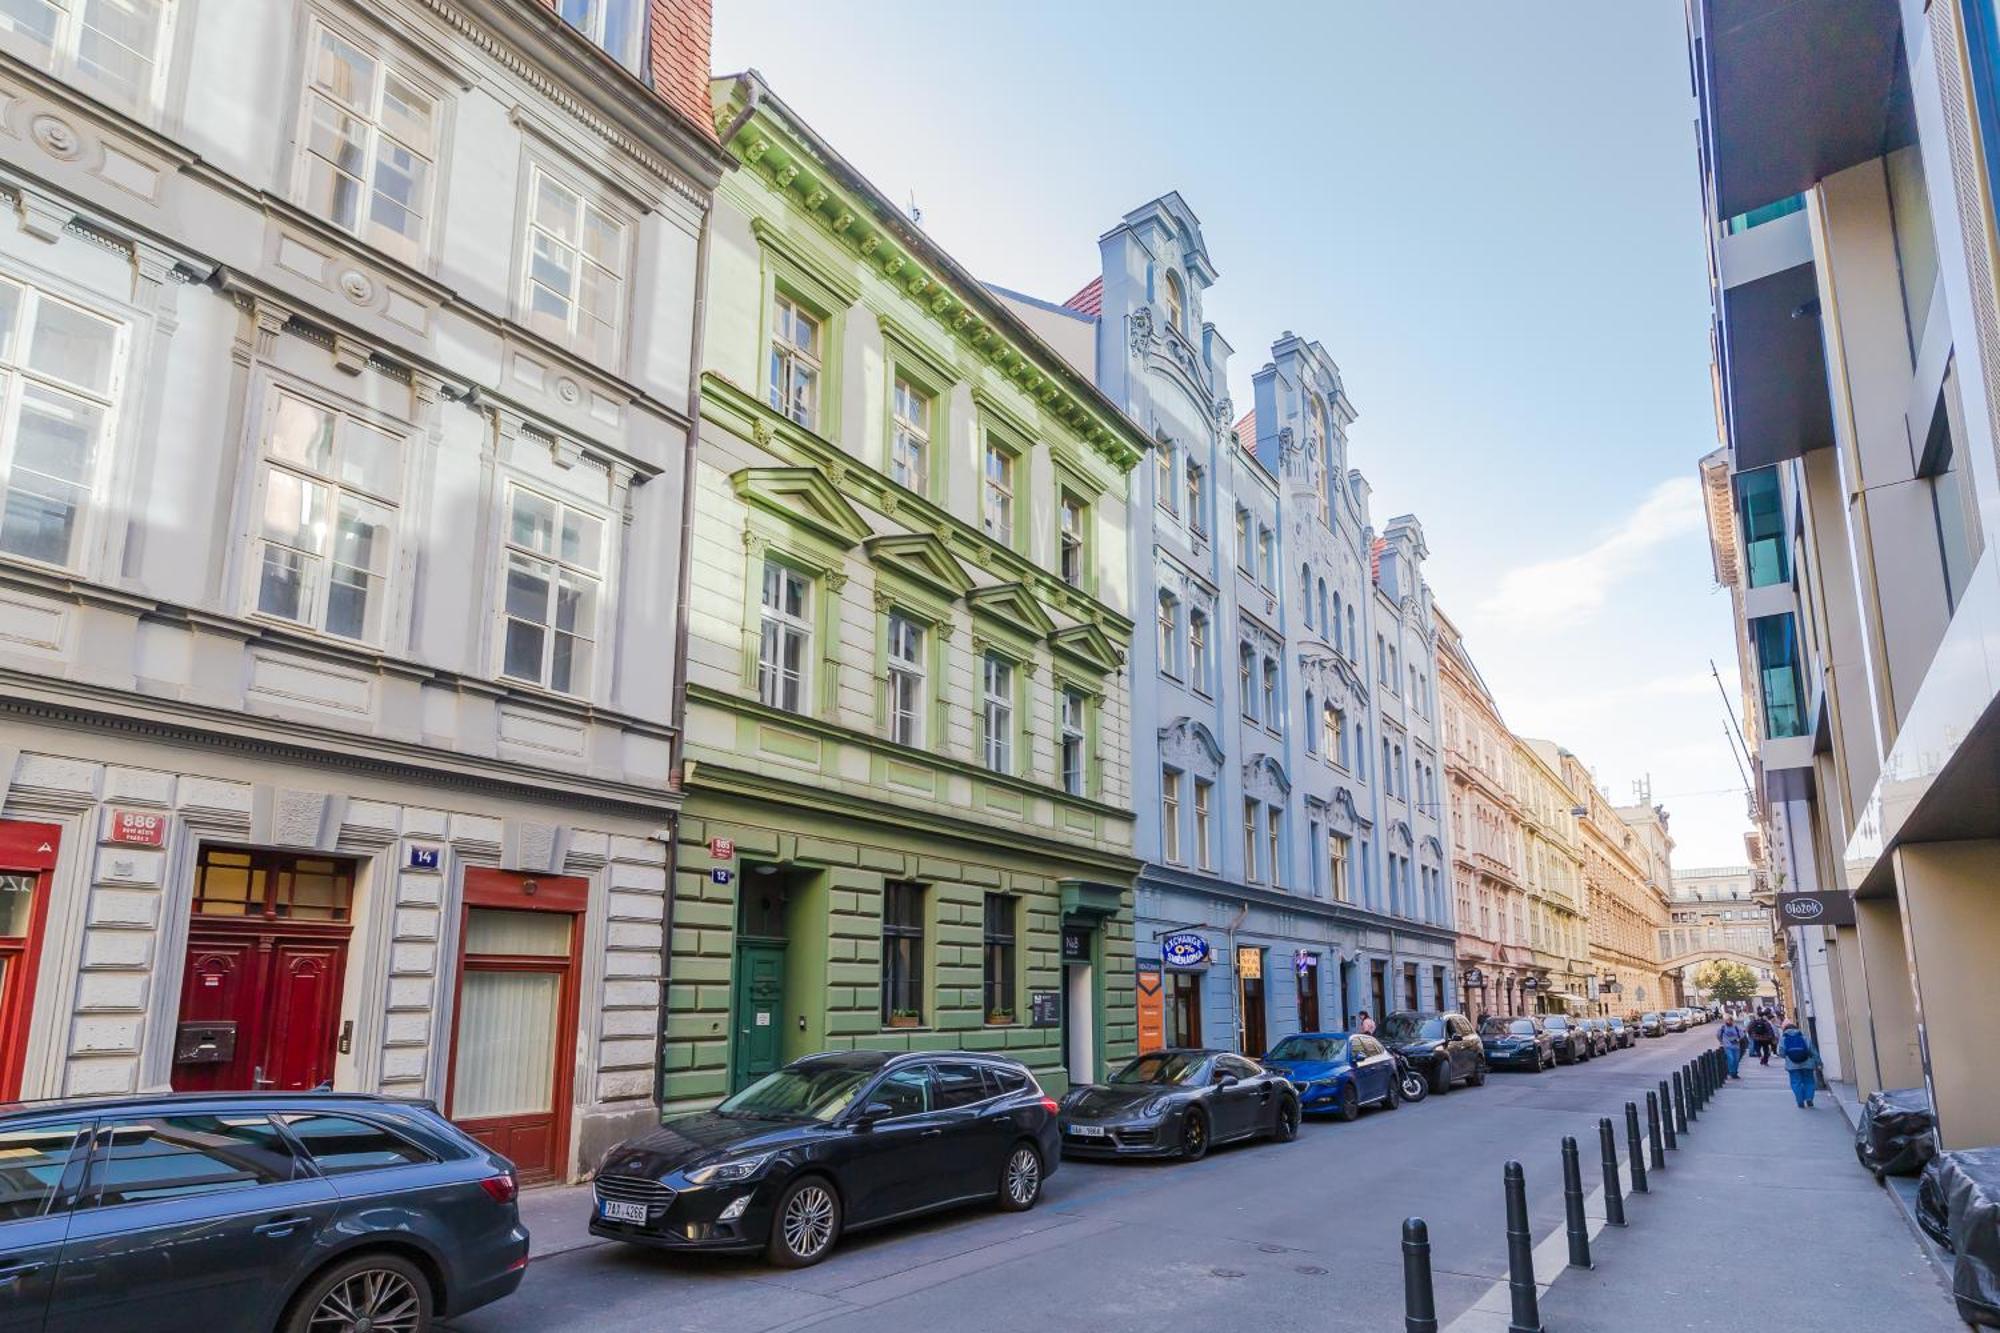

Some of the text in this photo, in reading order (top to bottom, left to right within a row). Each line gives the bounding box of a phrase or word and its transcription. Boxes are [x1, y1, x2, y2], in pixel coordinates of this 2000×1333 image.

[123, 813, 156, 829] 886
[418, 851, 431, 863] 14
[717, 871, 726, 881] 12
[1165, 935, 1202, 952] EXCHANGE
[1175, 945, 1195, 954] 0%
